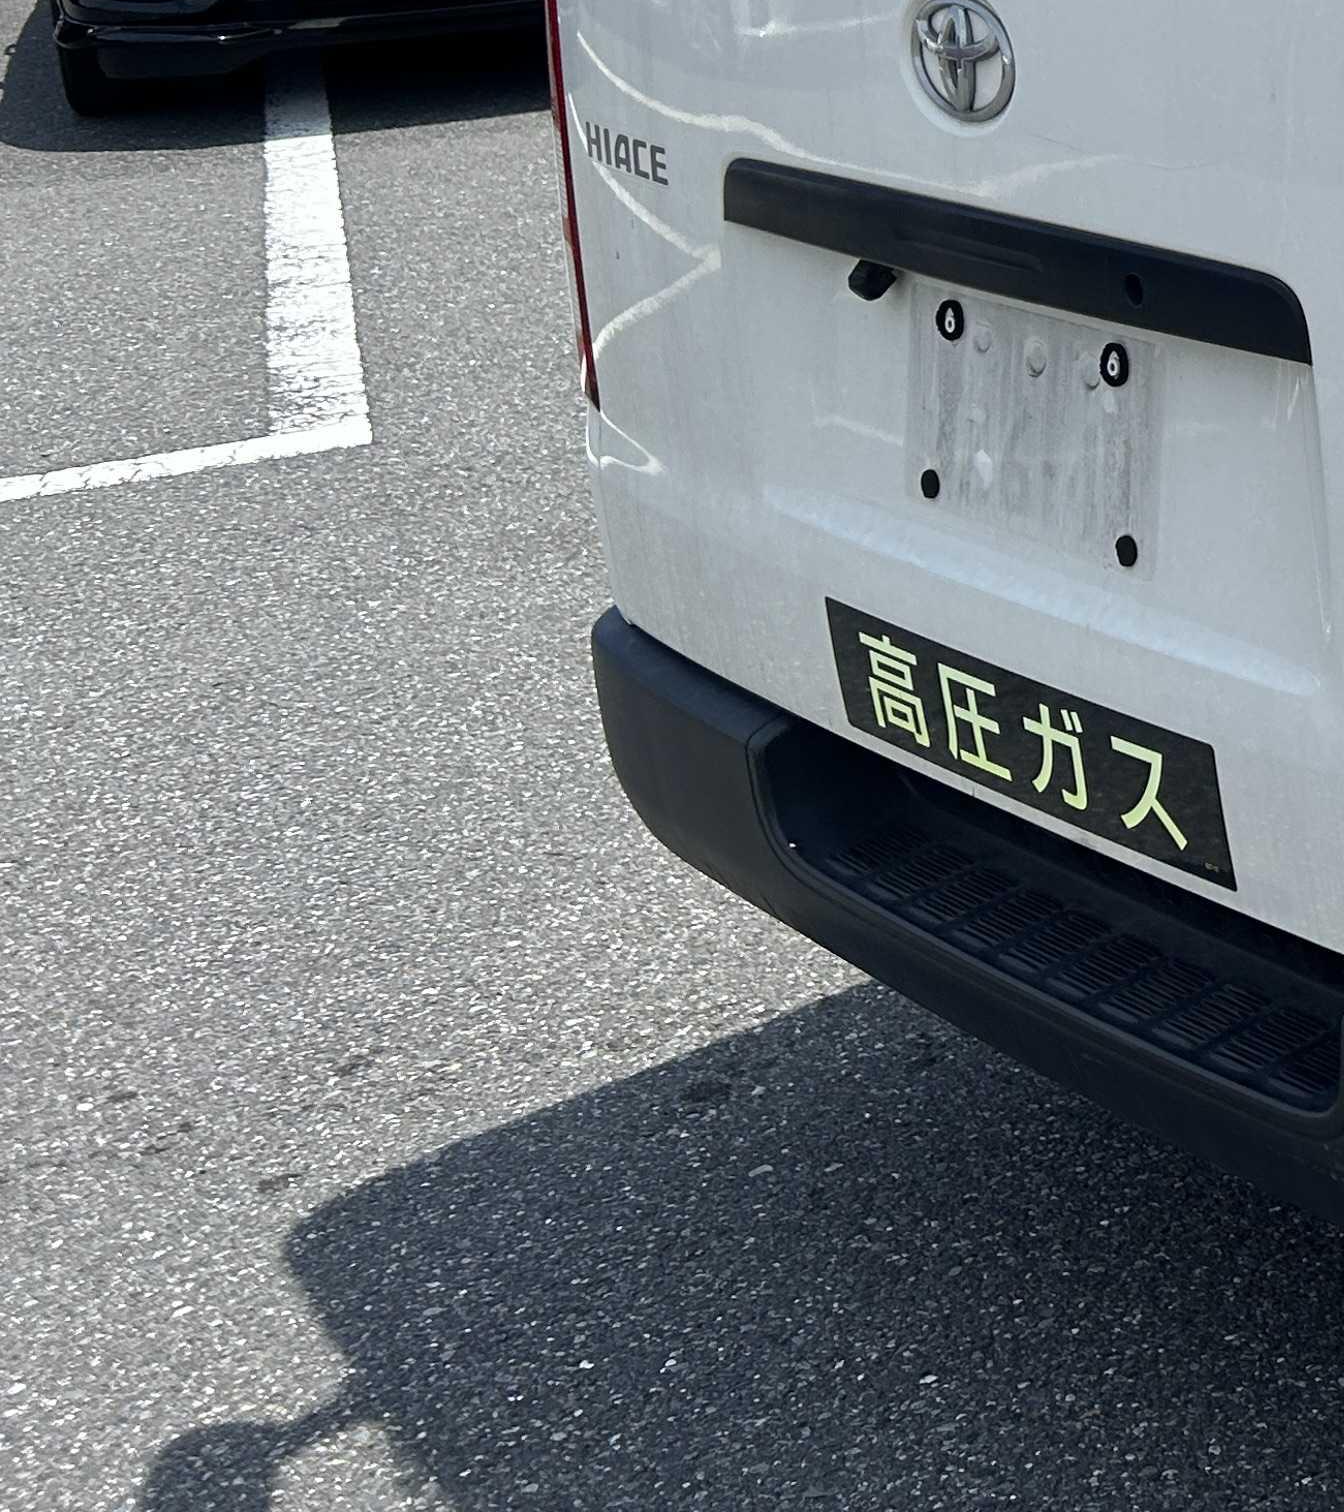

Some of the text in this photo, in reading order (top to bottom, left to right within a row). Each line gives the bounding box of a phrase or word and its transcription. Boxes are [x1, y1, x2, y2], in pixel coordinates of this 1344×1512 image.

[585, 121, 669, 186] HIACE
[858, 631, 1188, 851] 高圧ガス
